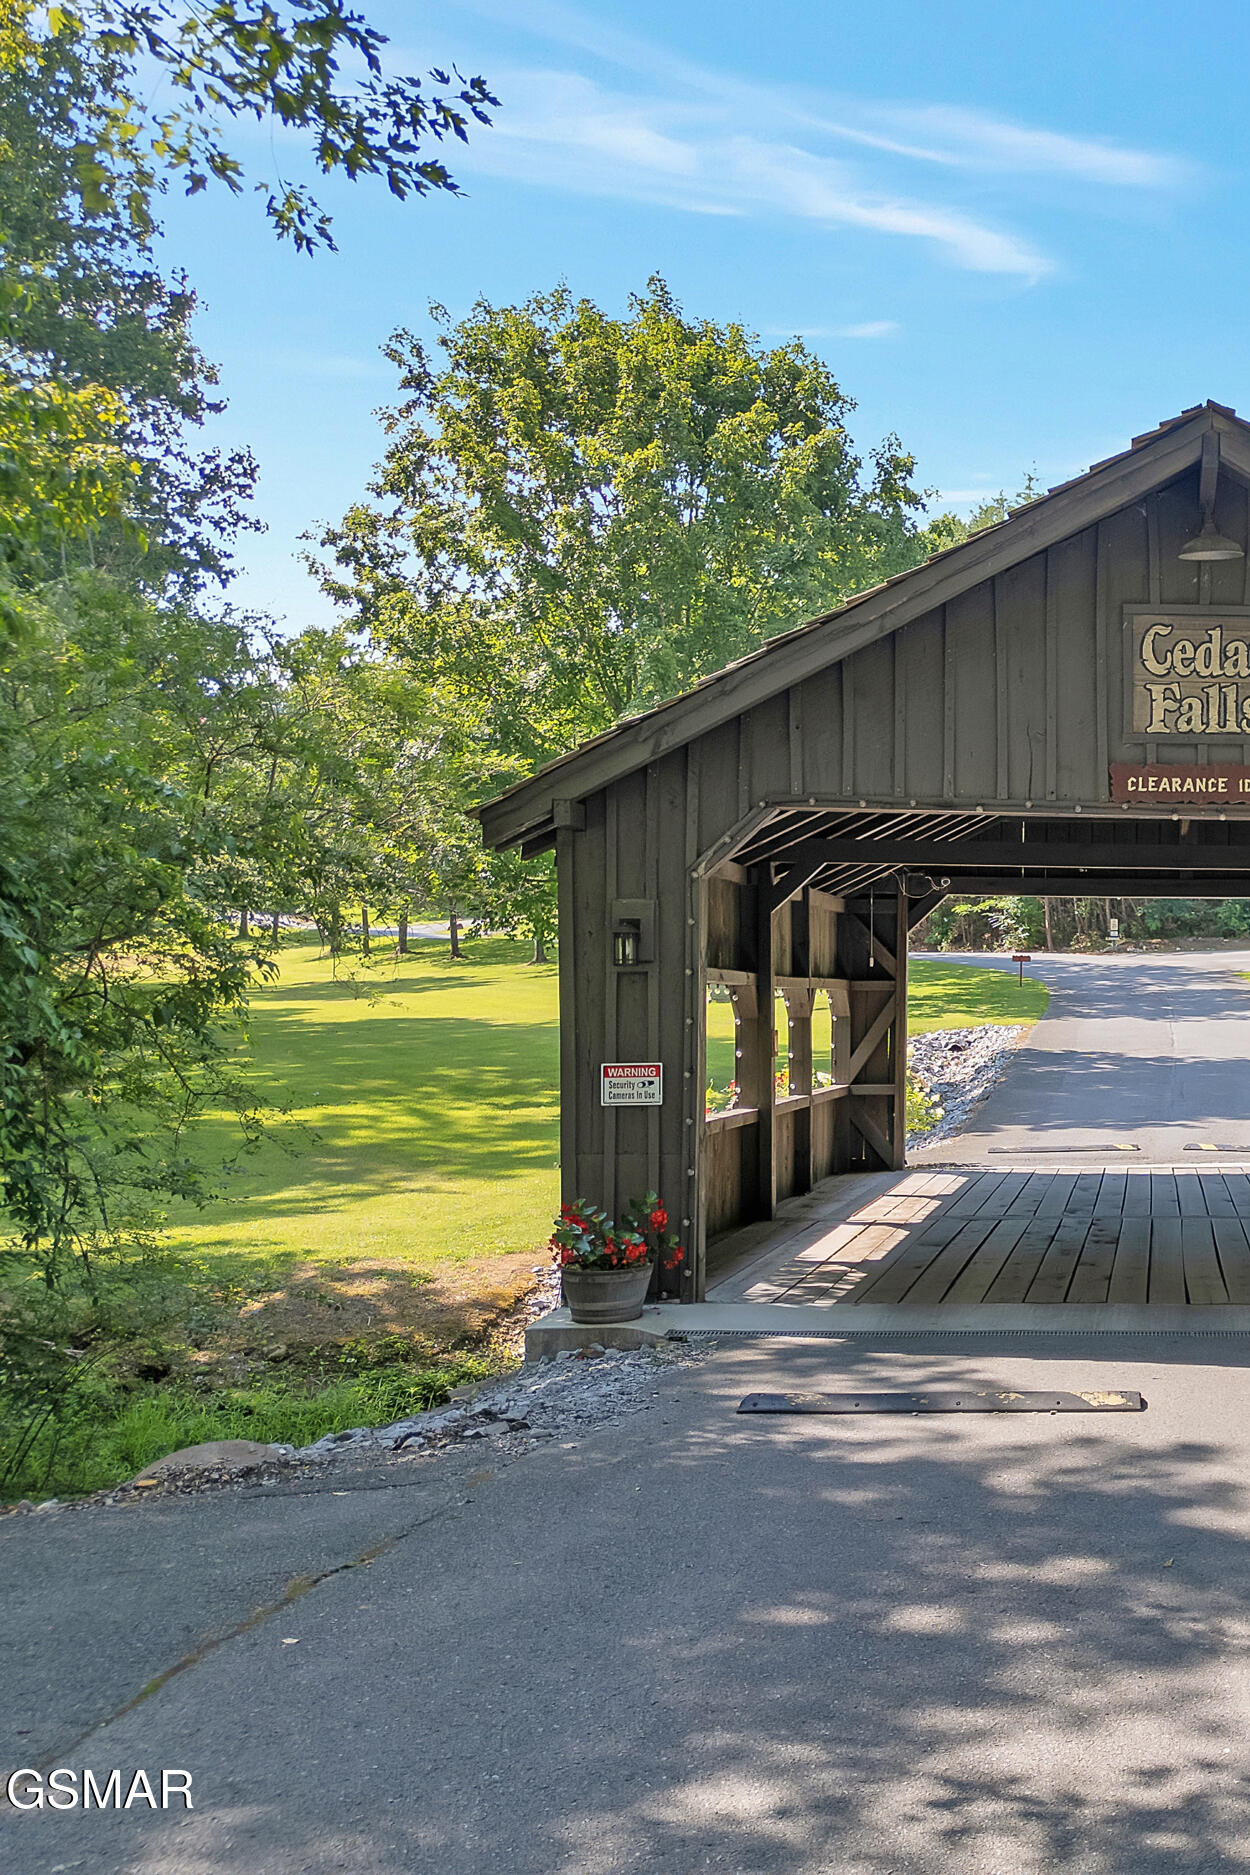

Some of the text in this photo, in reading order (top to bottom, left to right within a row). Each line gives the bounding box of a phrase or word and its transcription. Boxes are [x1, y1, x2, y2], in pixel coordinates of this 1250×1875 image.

[1127, 776, 1228, 793] CLEARANCE
[607, 1067, 656, 1077] WARNING
[608, 1080, 635, 1090] Security
[608, 1091, 655, 1100] Cameras In Use
